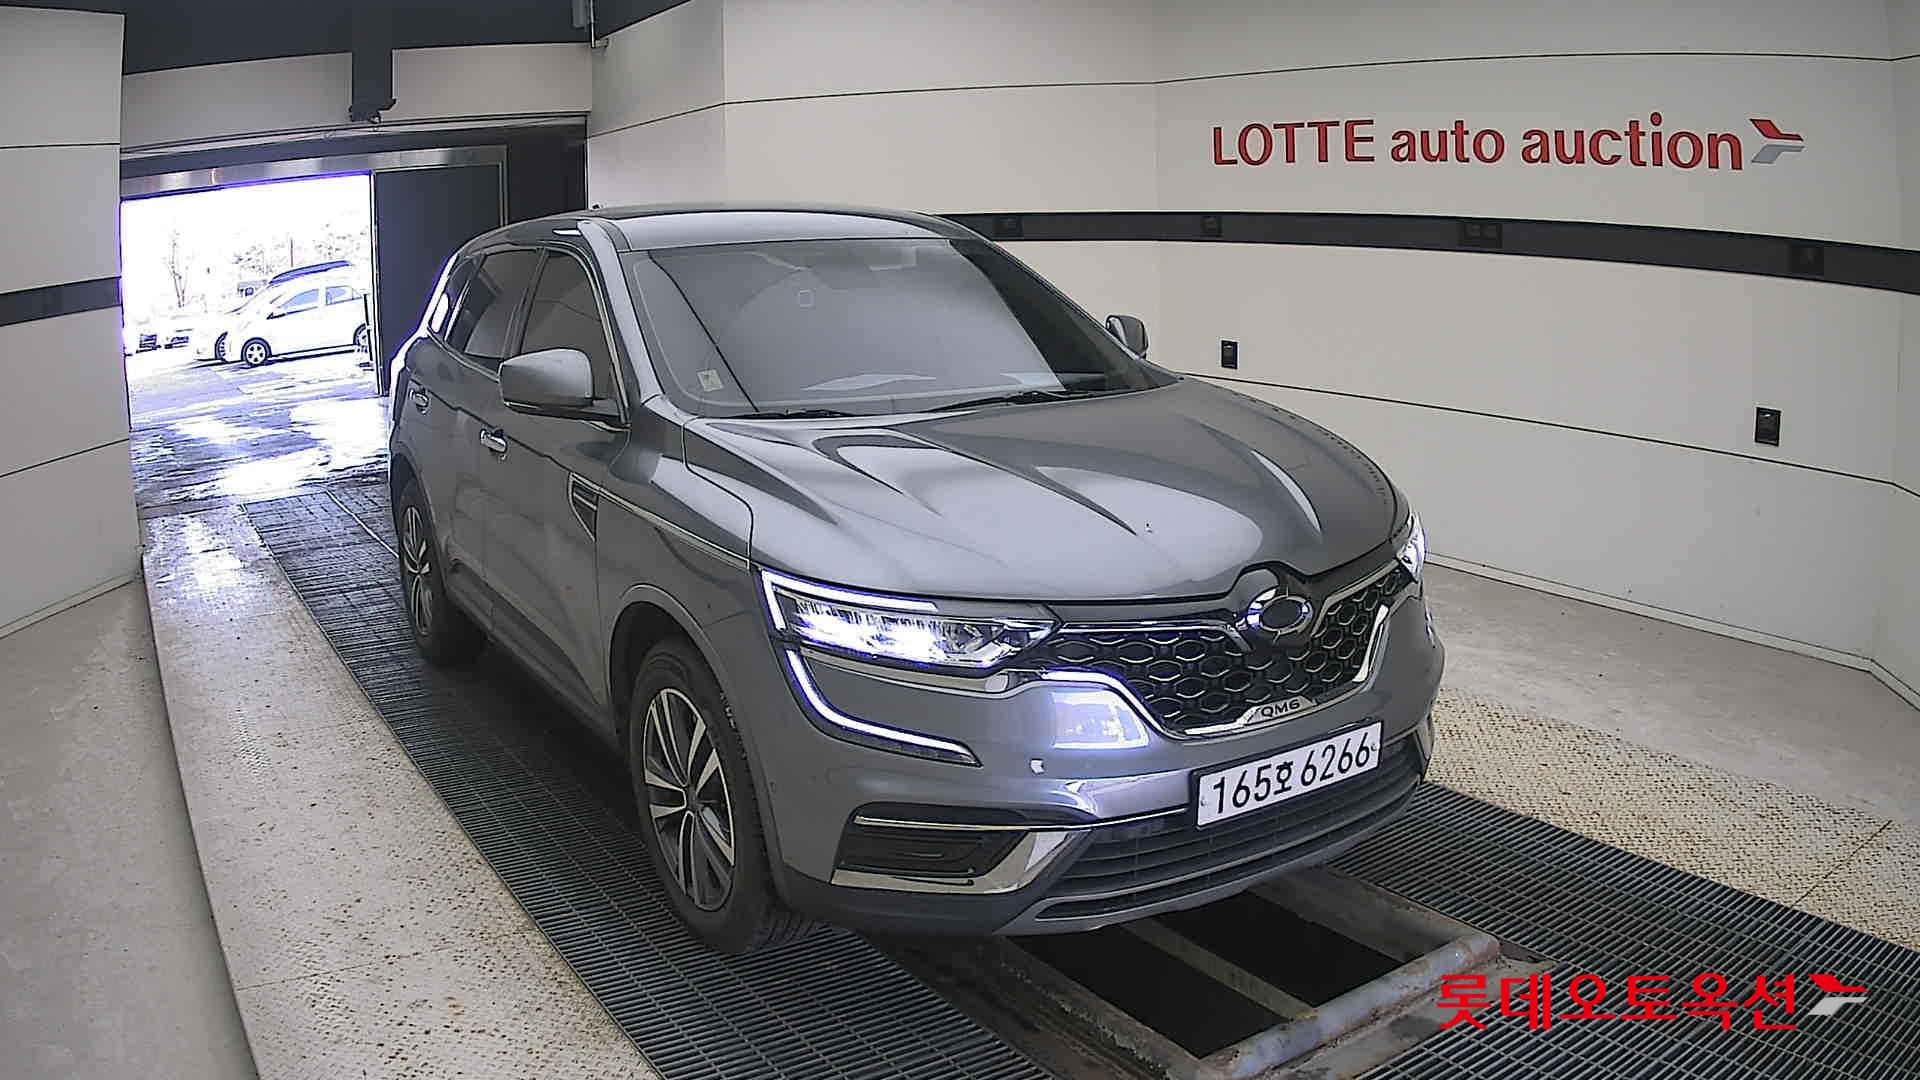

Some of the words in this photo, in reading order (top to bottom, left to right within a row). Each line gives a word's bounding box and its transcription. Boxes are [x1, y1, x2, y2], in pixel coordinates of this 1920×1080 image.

[1213, 119, 1375, 166] LOTTE
[1391, 120, 1506, 164] auto
[1521, 112, 1743, 171] auction
[1261, 699, 1300, 717] QM6
